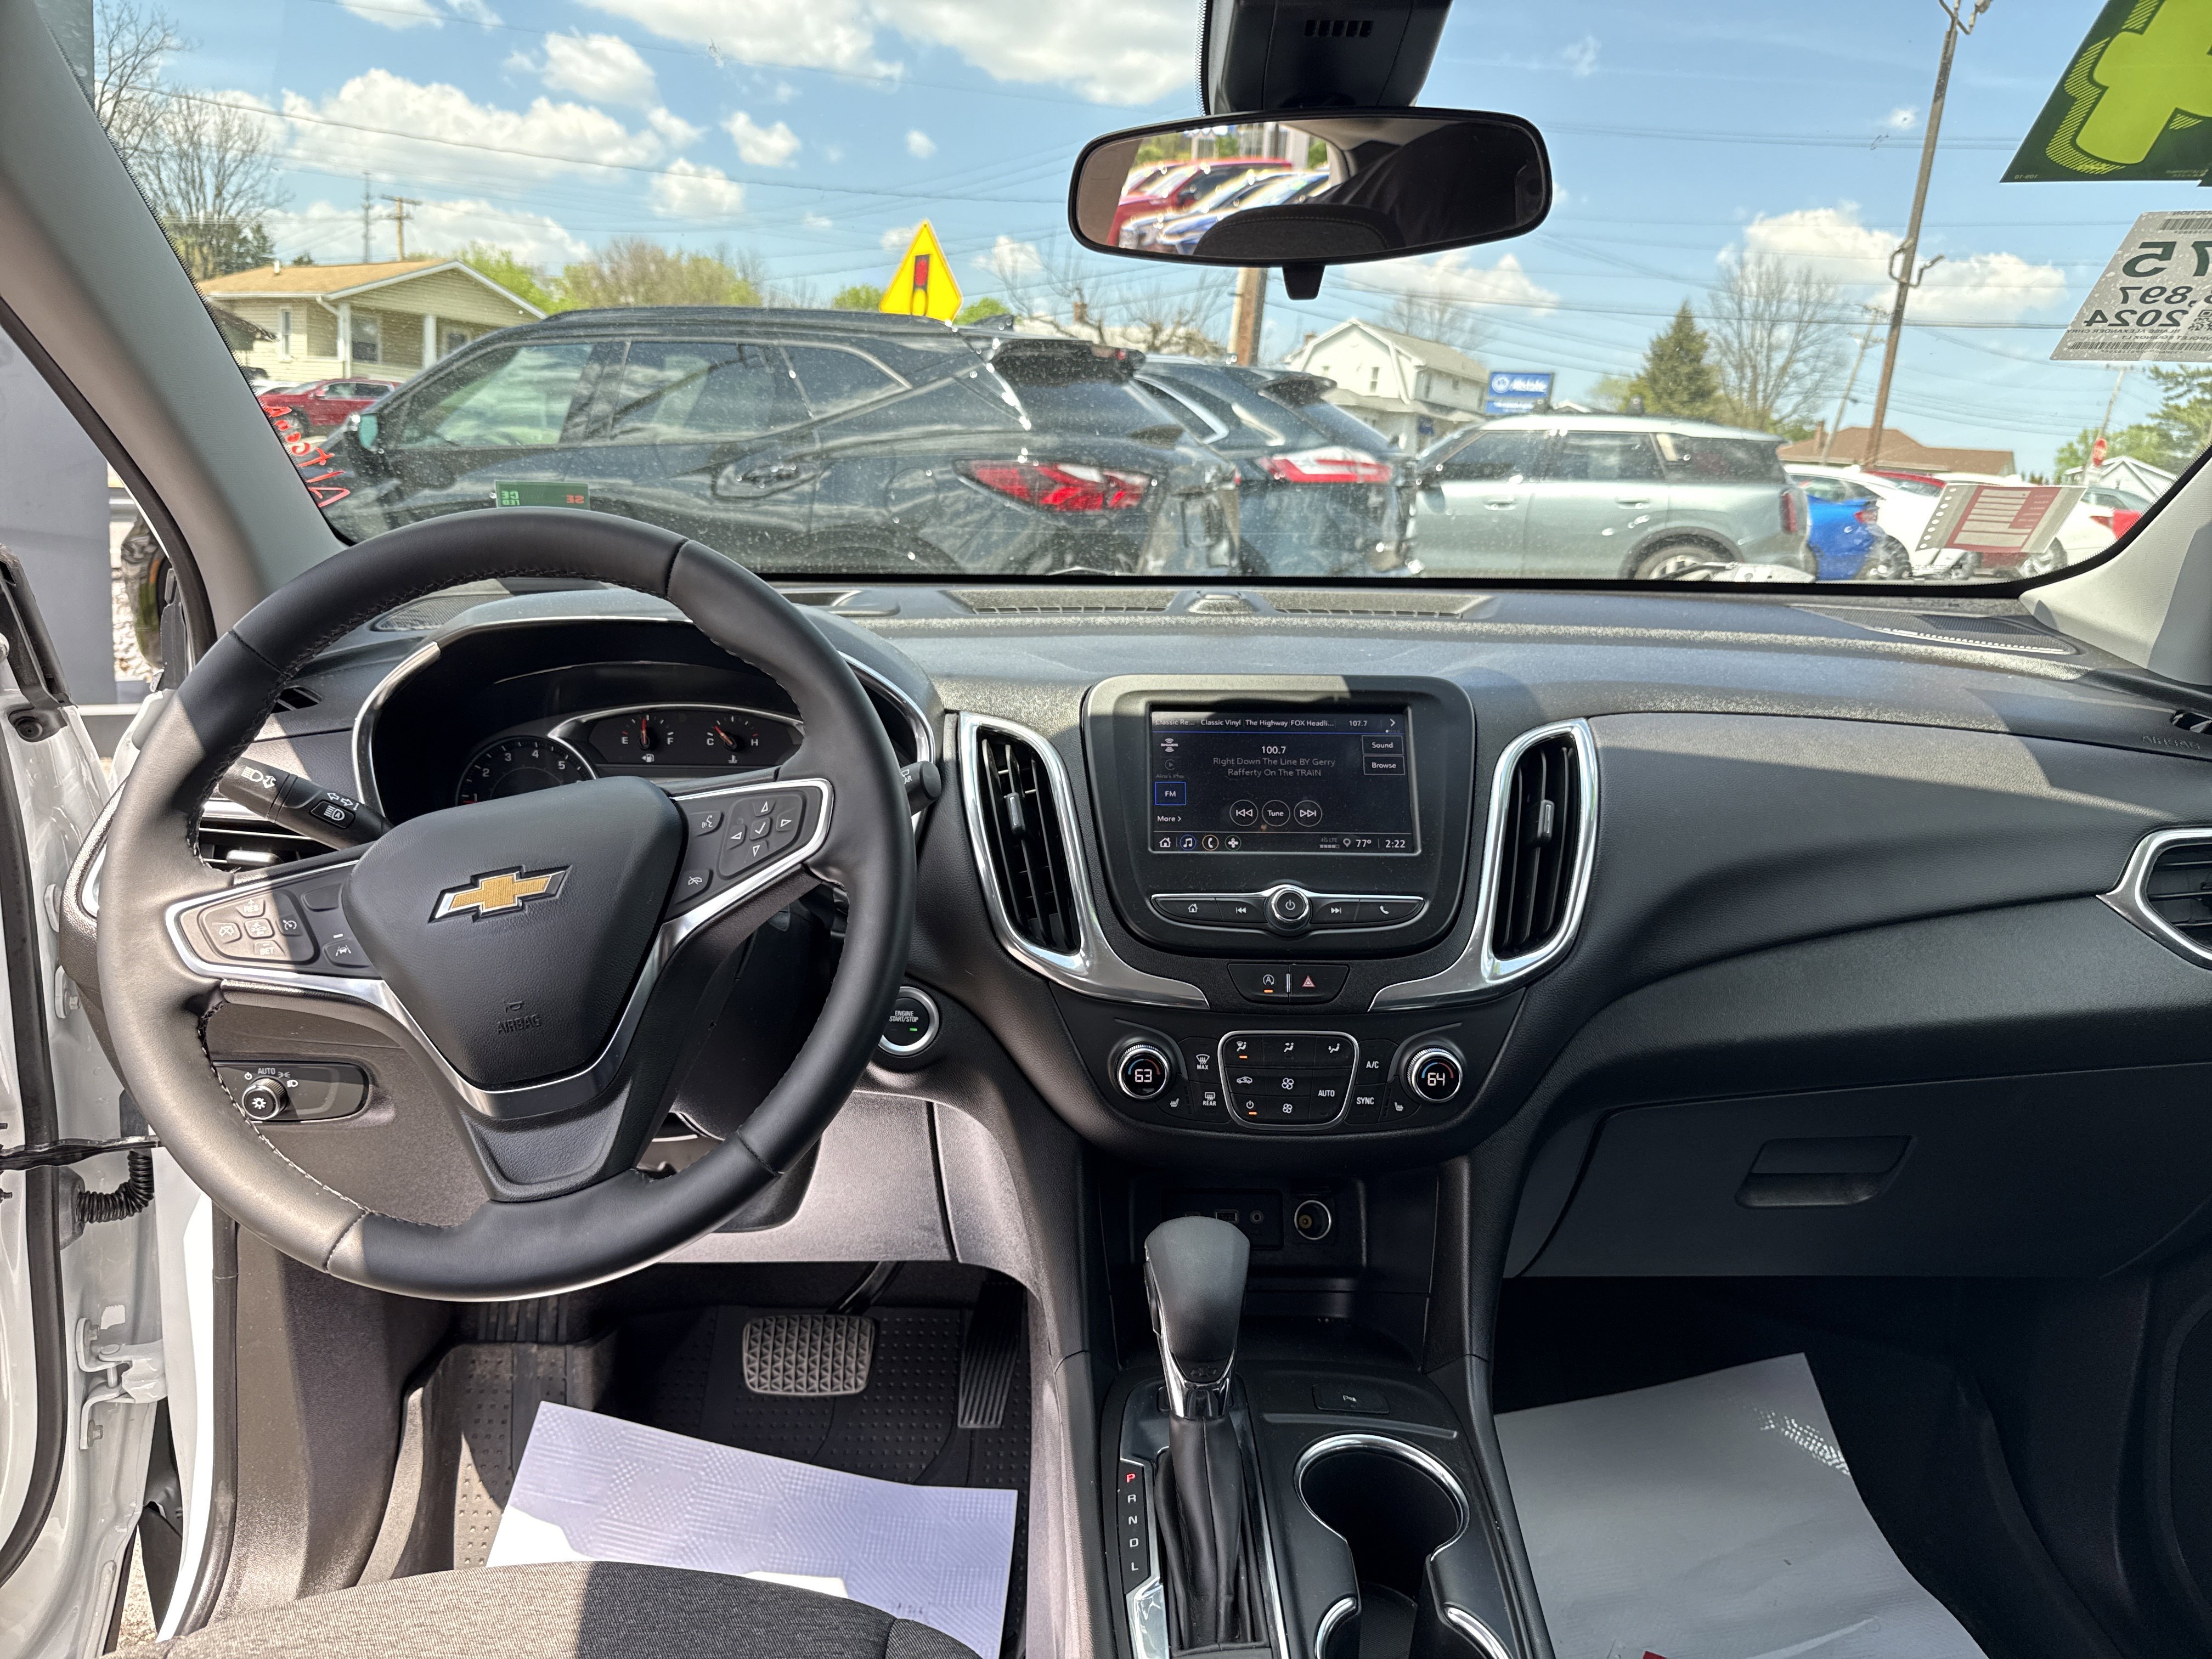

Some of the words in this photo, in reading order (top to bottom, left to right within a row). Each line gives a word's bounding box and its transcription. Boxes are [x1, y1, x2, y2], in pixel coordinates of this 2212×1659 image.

[1260, 719, 1288, 727] Highway
[751, 738, 758, 746] H
[532, 749, 539, 758] 4
[1261, 746, 1286, 754] 100.7
[505, 753, 512, 761] 3
[558, 761, 566, 770] 5
[1213, 758, 1235, 767] Right
[1312, 759, 1335, 767] Gerry
[483, 768, 489, 777] 2
[1228, 769, 1262, 777] Rafferty
[1385, 839, 1406, 848] 2:22
[244, 904, 259, 912] RES
[259, 946, 275, 955] SET
[496, 1014, 542, 1034] AIRBAG
[1365, 1060, 1379, 1070] A/C
[1134, 1069, 1152, 1082] 63
[1427, 1073, 1446, 1086] 64
[1318, 1090, 1335, 1098] AUTO
[1356, 1097, 1374, 1105] SYNC
[1126, 1473, 1136, 1482] P
[1127, 1494, 1136, 1503] R
[1128, 1515, 1138, 1525] N
[1129, 1538, 1139, 1548] D
[1131, 1562, 1139, 1571] L
